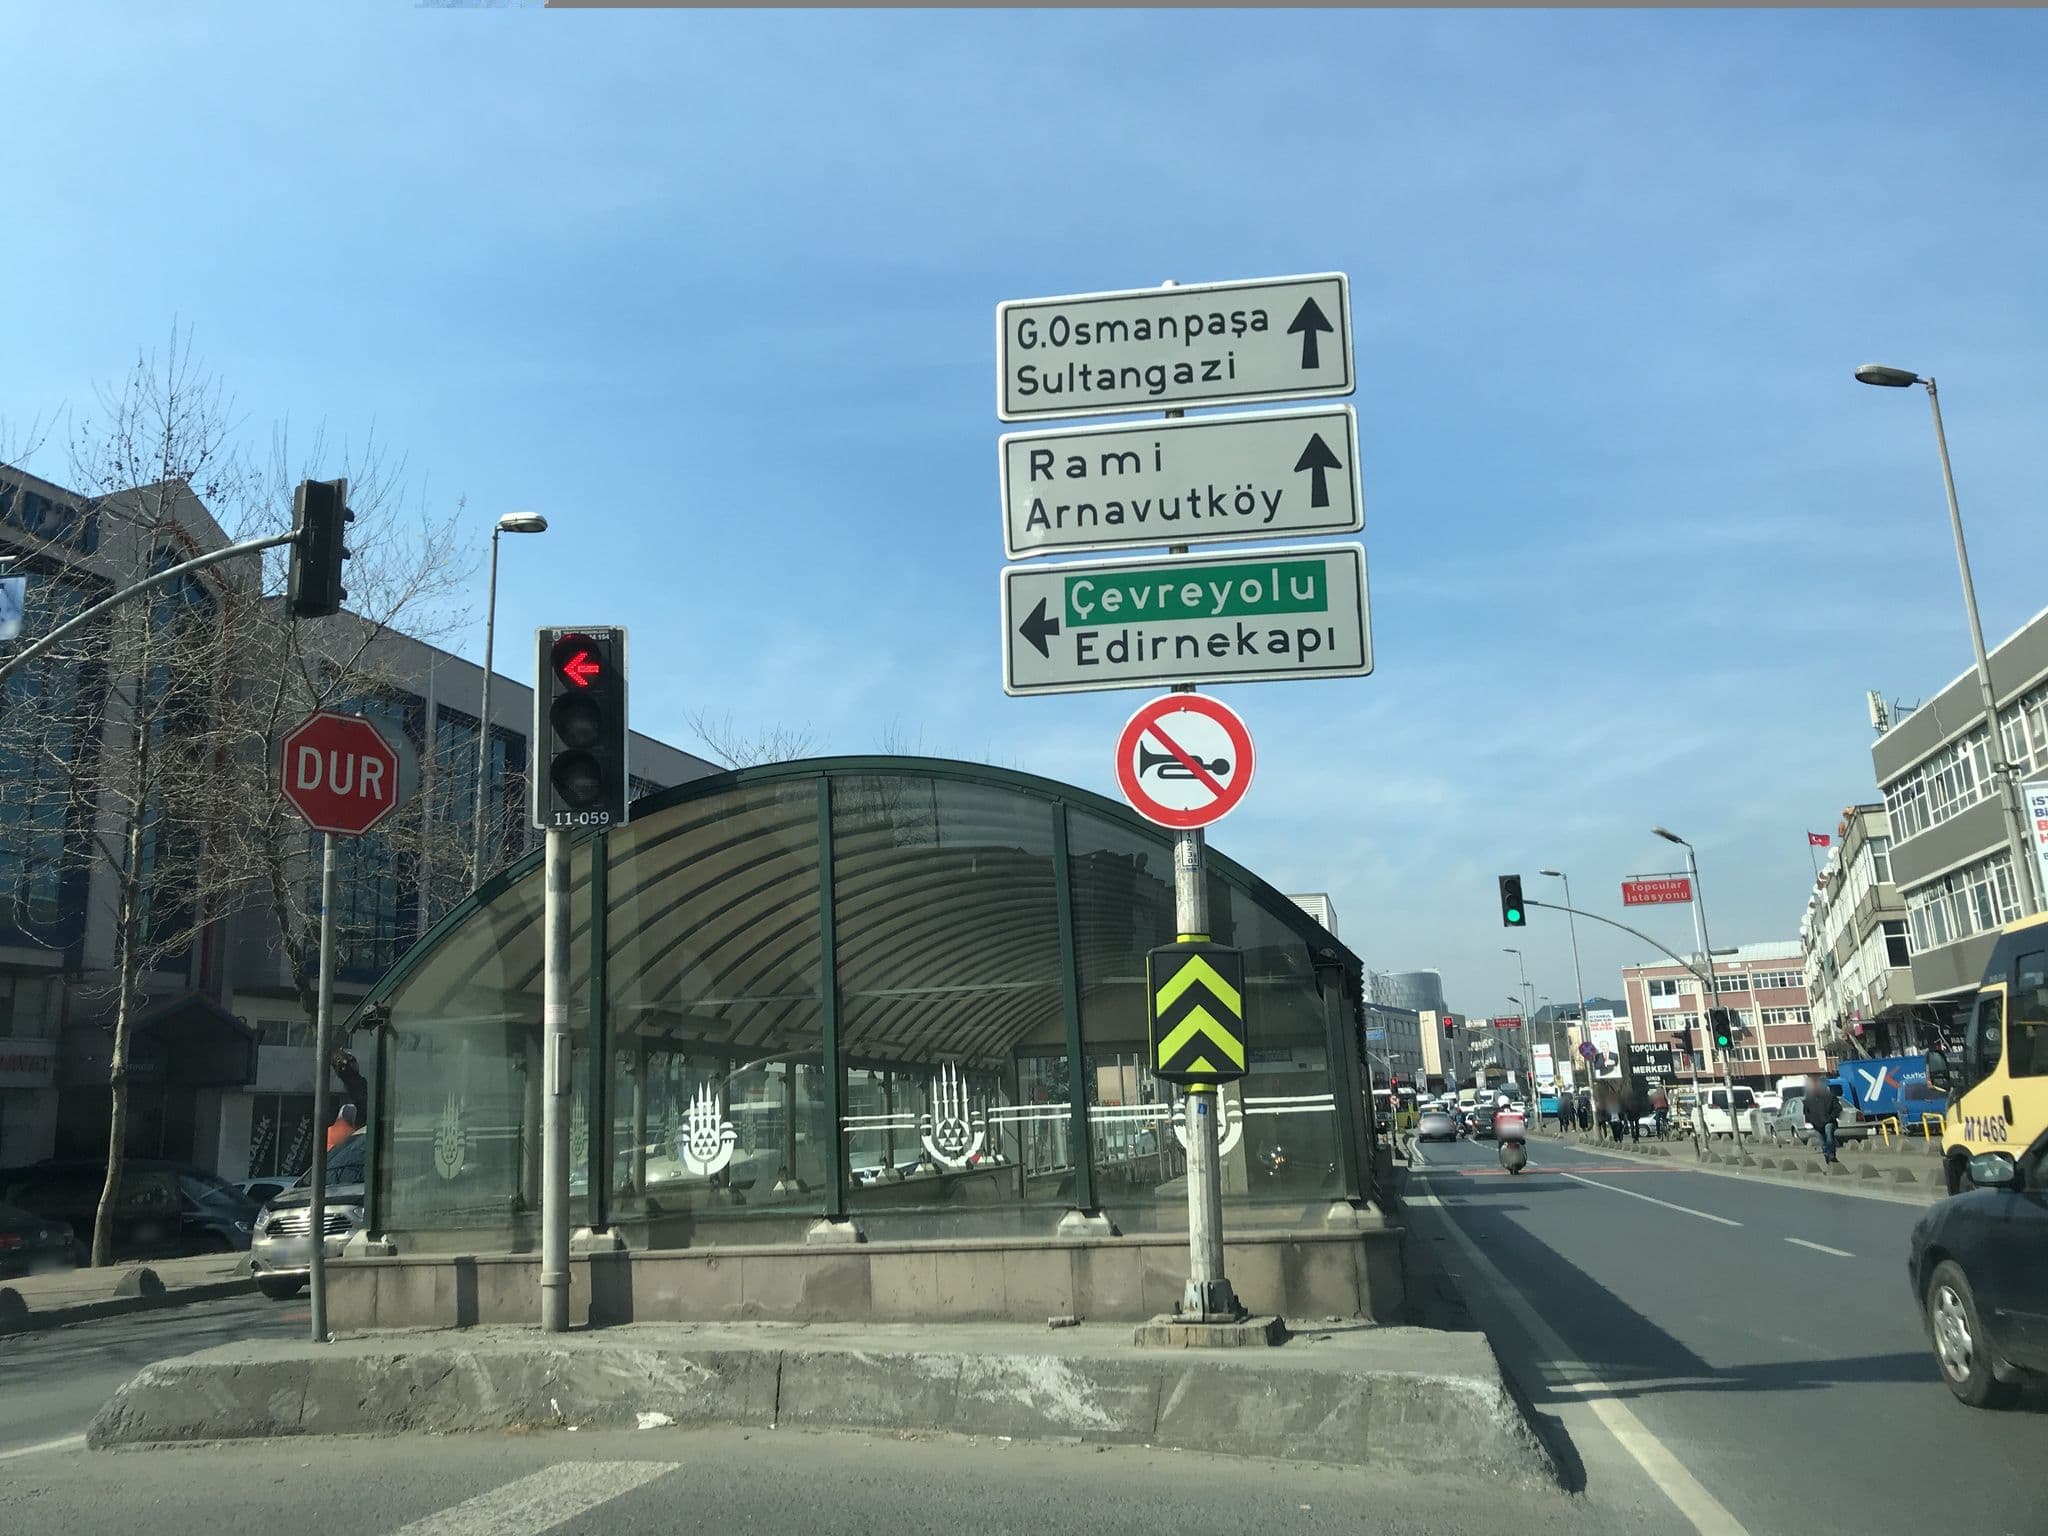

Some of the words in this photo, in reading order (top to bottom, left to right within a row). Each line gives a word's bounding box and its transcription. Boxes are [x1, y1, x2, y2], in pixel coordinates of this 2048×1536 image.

[1017, 308, 1269, 350] G.Osmanpaşa
[1017, 351, 1236, 395] Sultangazi
[1030, 442, 1162, 482] Rami
[1025, 484, 1284, 532] Arnavutköy
[1071, 567, 1315, 620] Çevreyolu
[1076, 621, 1335, 666] Edirnekapı
[297, 745, 385, 800] DUR
[555, 811, 610, 826] 11-059
[1630, 1043, 1669, 1054] TOPÇULAR
[1632, 1063, 1672, 1074] MERKEZİ
